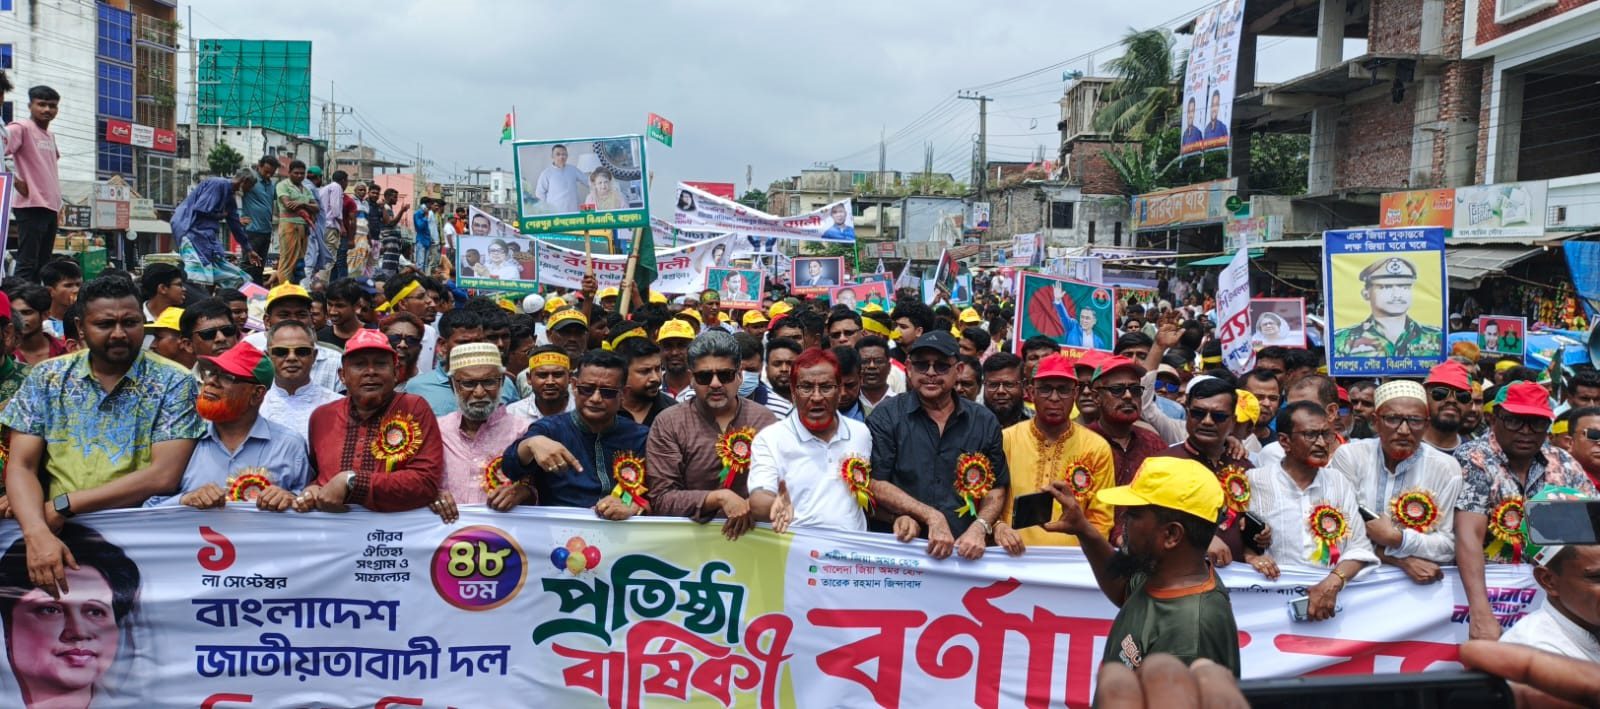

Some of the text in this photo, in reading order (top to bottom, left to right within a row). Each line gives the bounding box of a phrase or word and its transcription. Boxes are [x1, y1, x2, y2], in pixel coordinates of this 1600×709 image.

[1346, 231, 1363, 240] এক
[1365, 230, 1386, 240] জিয়া
[1365, 241, 1386, 251] জিয়া
[1388, 241, 1406, 250] ঘরে
[1409, 241, 1427, 249] ঘরে
[367, 529, 403, 543] গৌরব
[197, 526, 236, 572] ১
[362, 544, 403, 558] ঐতিহ্য
[356, 559, 409, 571] সংগ্রাম ও
[448, 540, 512, 578] ৪৮
[202, 573, 288, 590] লা সেপ্টেম্বর
[355, 572, 410, 583] সাফল্যের
[820, 578, 850, 588] তারেক
[853, 578, 881, 589] রহমান
[458, 580, 498, 600] তম
[532, 554, 745, 647] প্রতিষ্ঠা
[191, 598, 400, 631] বাংলাদেশ
[195, 632, 511, 682] জাতীয়তাবাদী দল
[551, 613, 794, 709] বার্ষিকী
